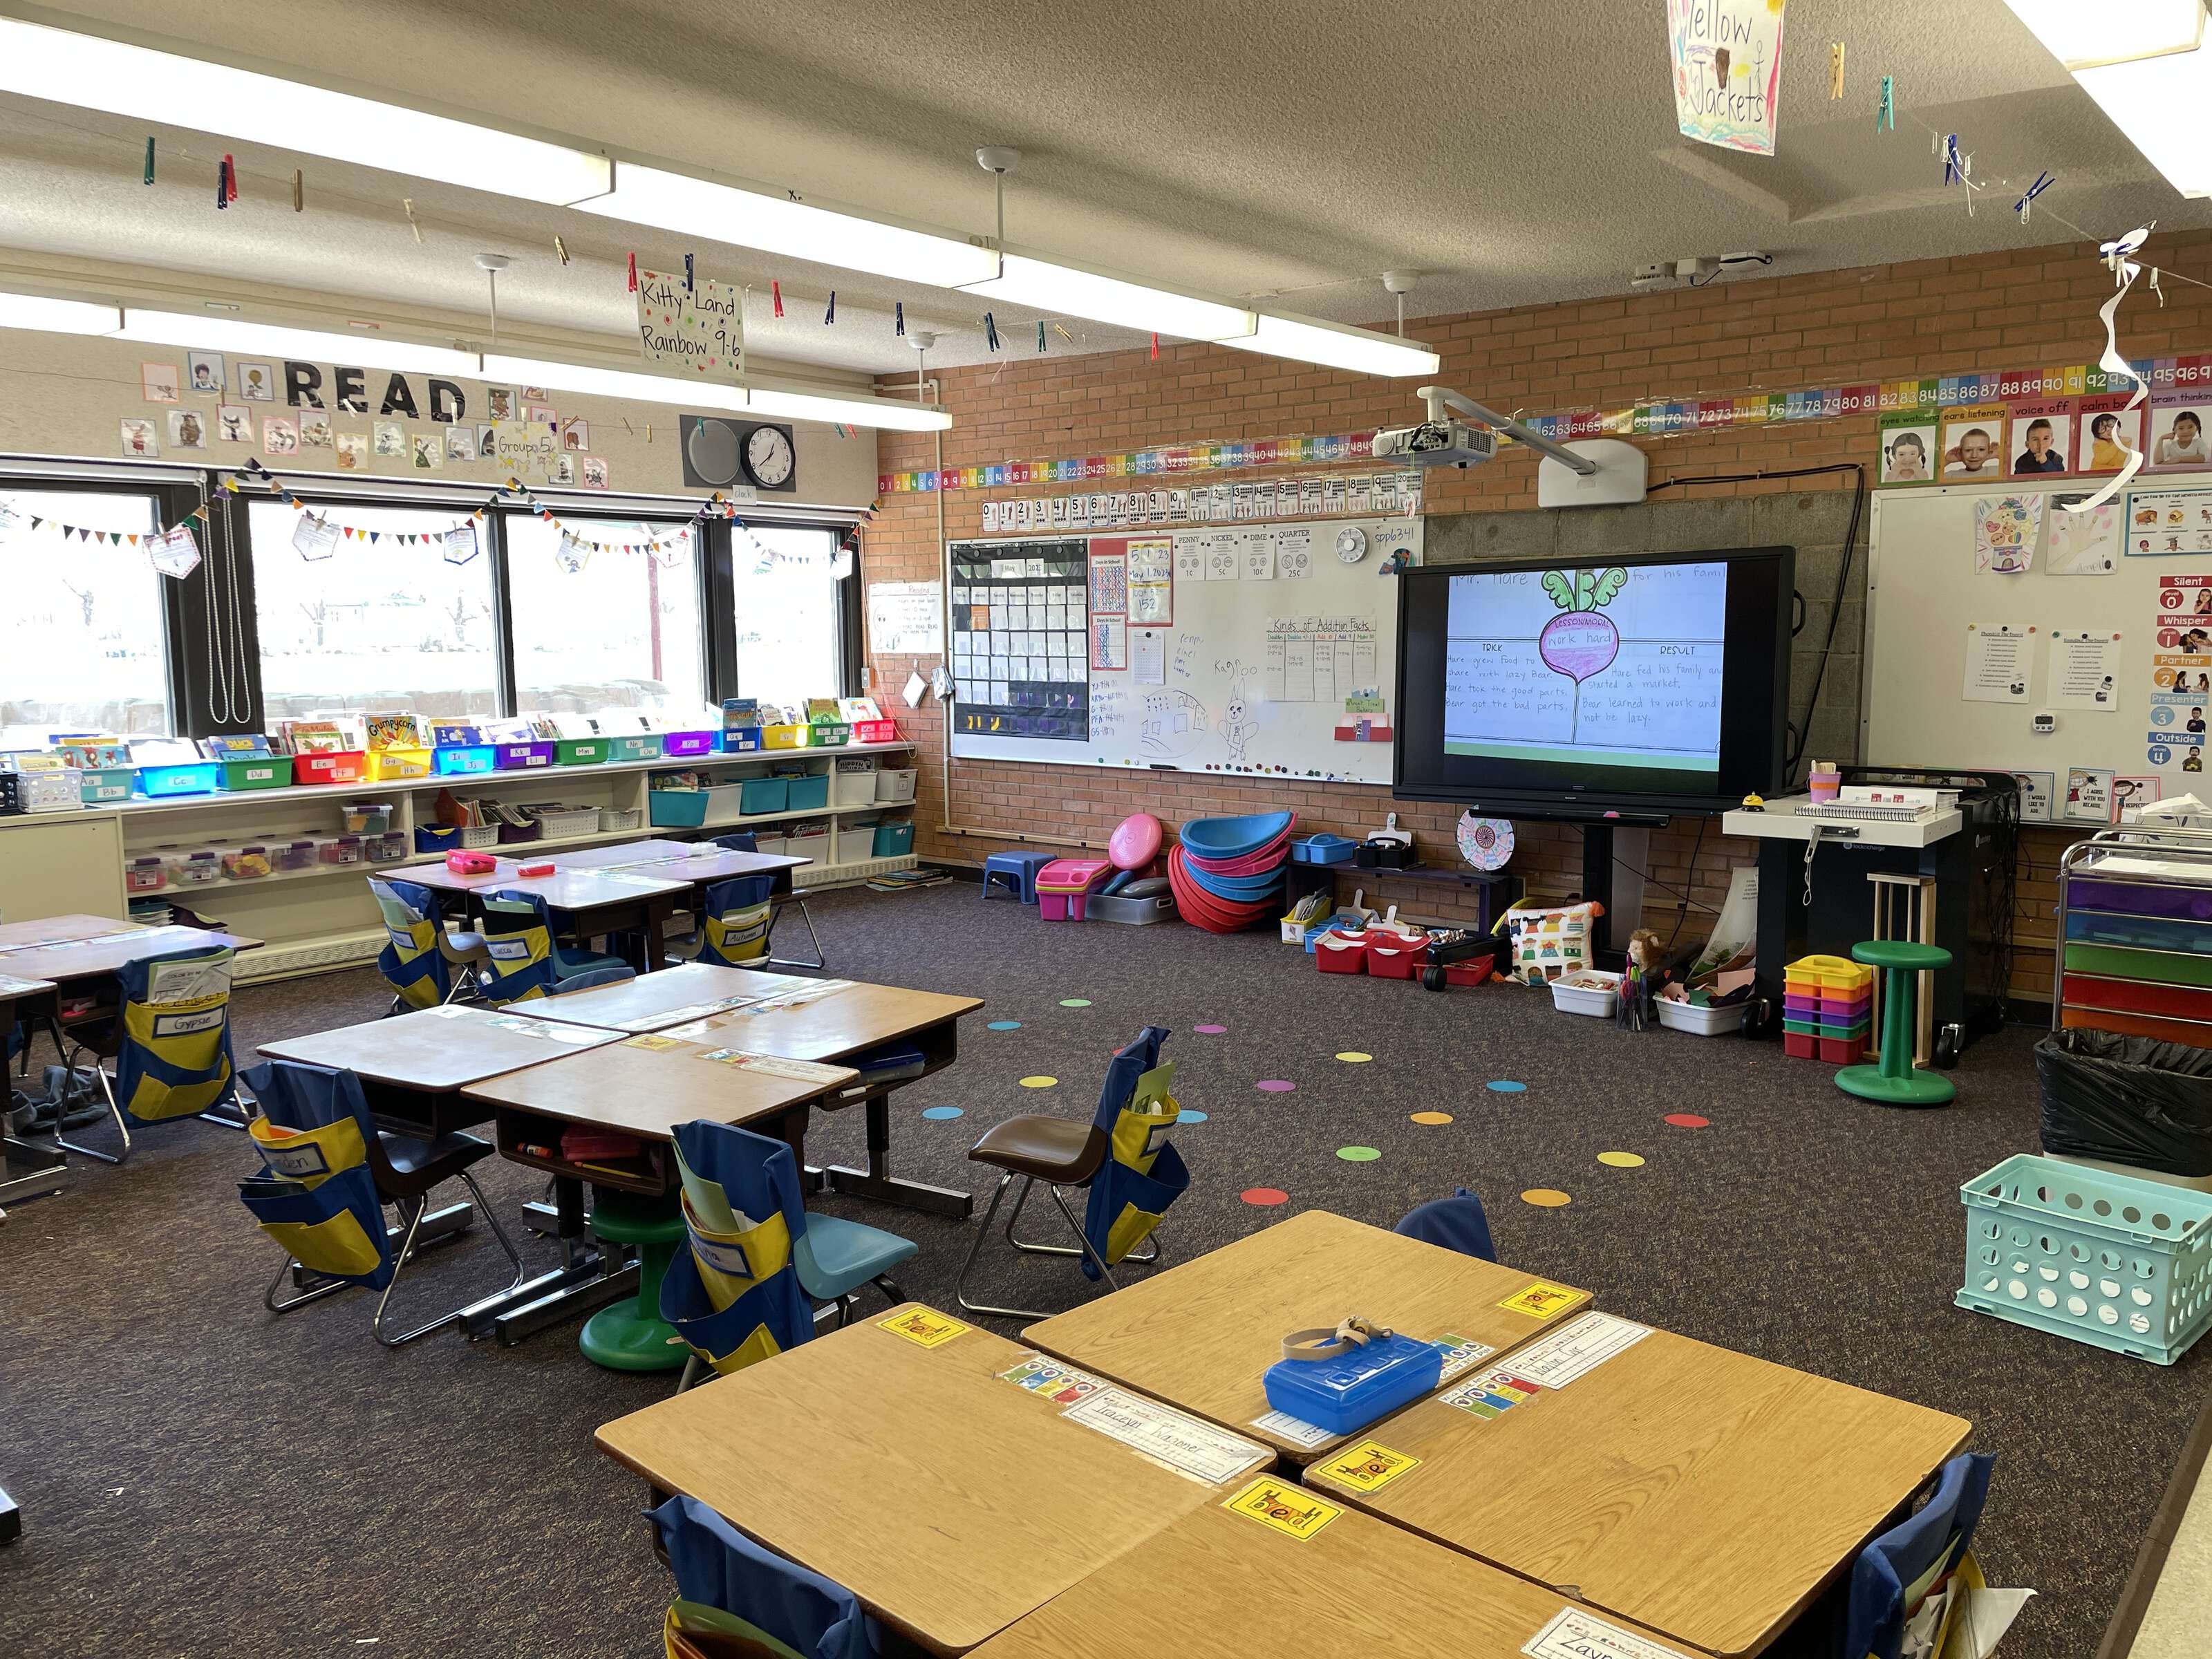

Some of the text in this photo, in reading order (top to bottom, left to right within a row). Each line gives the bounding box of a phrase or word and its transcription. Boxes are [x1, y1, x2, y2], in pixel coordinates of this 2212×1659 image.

[1689, 59, 1764, 122] Jackets
[640, 280, 735, 319] Kitty Land
[641, 325, 740, 357] Rainbow 9-6
[284, 361, 466, 422] READ
[1841, 397, 1859, 409] 80
[1863, 395, 1875, 407] 81
[1880, 393, 1897, 406] 82
[1900, 392, 1918, 404] 83
[1919, 389, 1937, 402] 84
[1939, 387, 1956, 400] 85
[1958, 386, 1976, 399] 86
[1980, 383, 1998, 396] 87
[2000, 382, 2019, 395] 88
[2021, 379, 2041, 393] 89
[2043, 377, 2063, 391] 90
[2068, 376, 2081, 389] 91
[2086, 374, 2106, 387] 92
[2153, 368, 2175, 382] 95
[2177, 367, 2197, 380] 96
[2150, 392, 2212, 404] brain thinkin
[2015, 400, 2070, 415] voice off
[2081, 399, 2108, 411] calm
[1902, 414, 1940, 423] watching
[1967, 409, 2005, 419] listening
[498, 435, 552, 457] Group 5
[1254, 445, 1325, 460] 40 41 42 43 44 45
[735, 487, 753, 498] clock
[1054, 494, 1155, 509] 4 5 6 7 8 9
[1279, 529, 1311, 538] QUARTER
[1375, 527, 1414, 550] spp6341
[1493, 572, 1528, 585] Hare
[1632, 570, 1653, 580] for
[1664, 568, 1682, 579] his
[2174, 577, 2203, 585] Silent
[1139, 598, 1156, 611] 152
[2166, 596, 2177, 608] 0
[1274, 618, 1369, 631] Kinds of Addition Facts
[2164, 616, 2208, 626] Whisper
[1548, 630, 1611, 646] work hard
[1482, 644, 1503, 653] TRICK
[1660, 646, 1696, 655] RESULT
[1474, 659, 1493, 668] grew
[2160, 655, 2204, 664] Partner
[1506, 668, 1526, 679] lazy
[1532, 671, 1553, 679] Bear.
[1612, 666, 1631, 677] Hare
[1660, 664, 1670, 673] his
[1642, 679, 1680, 688] market.
[2161, 675, 2171, 686] 2
[1468, 683, 1485, 691] took
[1512, 687, 1533, 699] good
[1583, 697, 1600, 708] Bear
[1609, 697, 1642, 709] learned
[1666, 698, 1692, 708] work
[1698, 697, 1716, 708] and
[2151, 694, 2206, 704] Presenter
[1472, 702, 1486, 713] got
[1493, 700, 1506, 708] the
[1584, 713, 1600, 722] not
[1629, 713, 1651, 727] lazy.
[2157, 714, 2166, 725] 3
[368, 719, 415, 736] Grumpycorn
[2155, 733, 2197, 743] Outside
[2154, 752, 2164, 764] 4
[174, 1016, 211, 1029] Gypsie
[894, 1314, 951, 1340] bed
[1335, 1449, 1404, 1483] bed
[1246, 1489, 1323, 1530] bed
